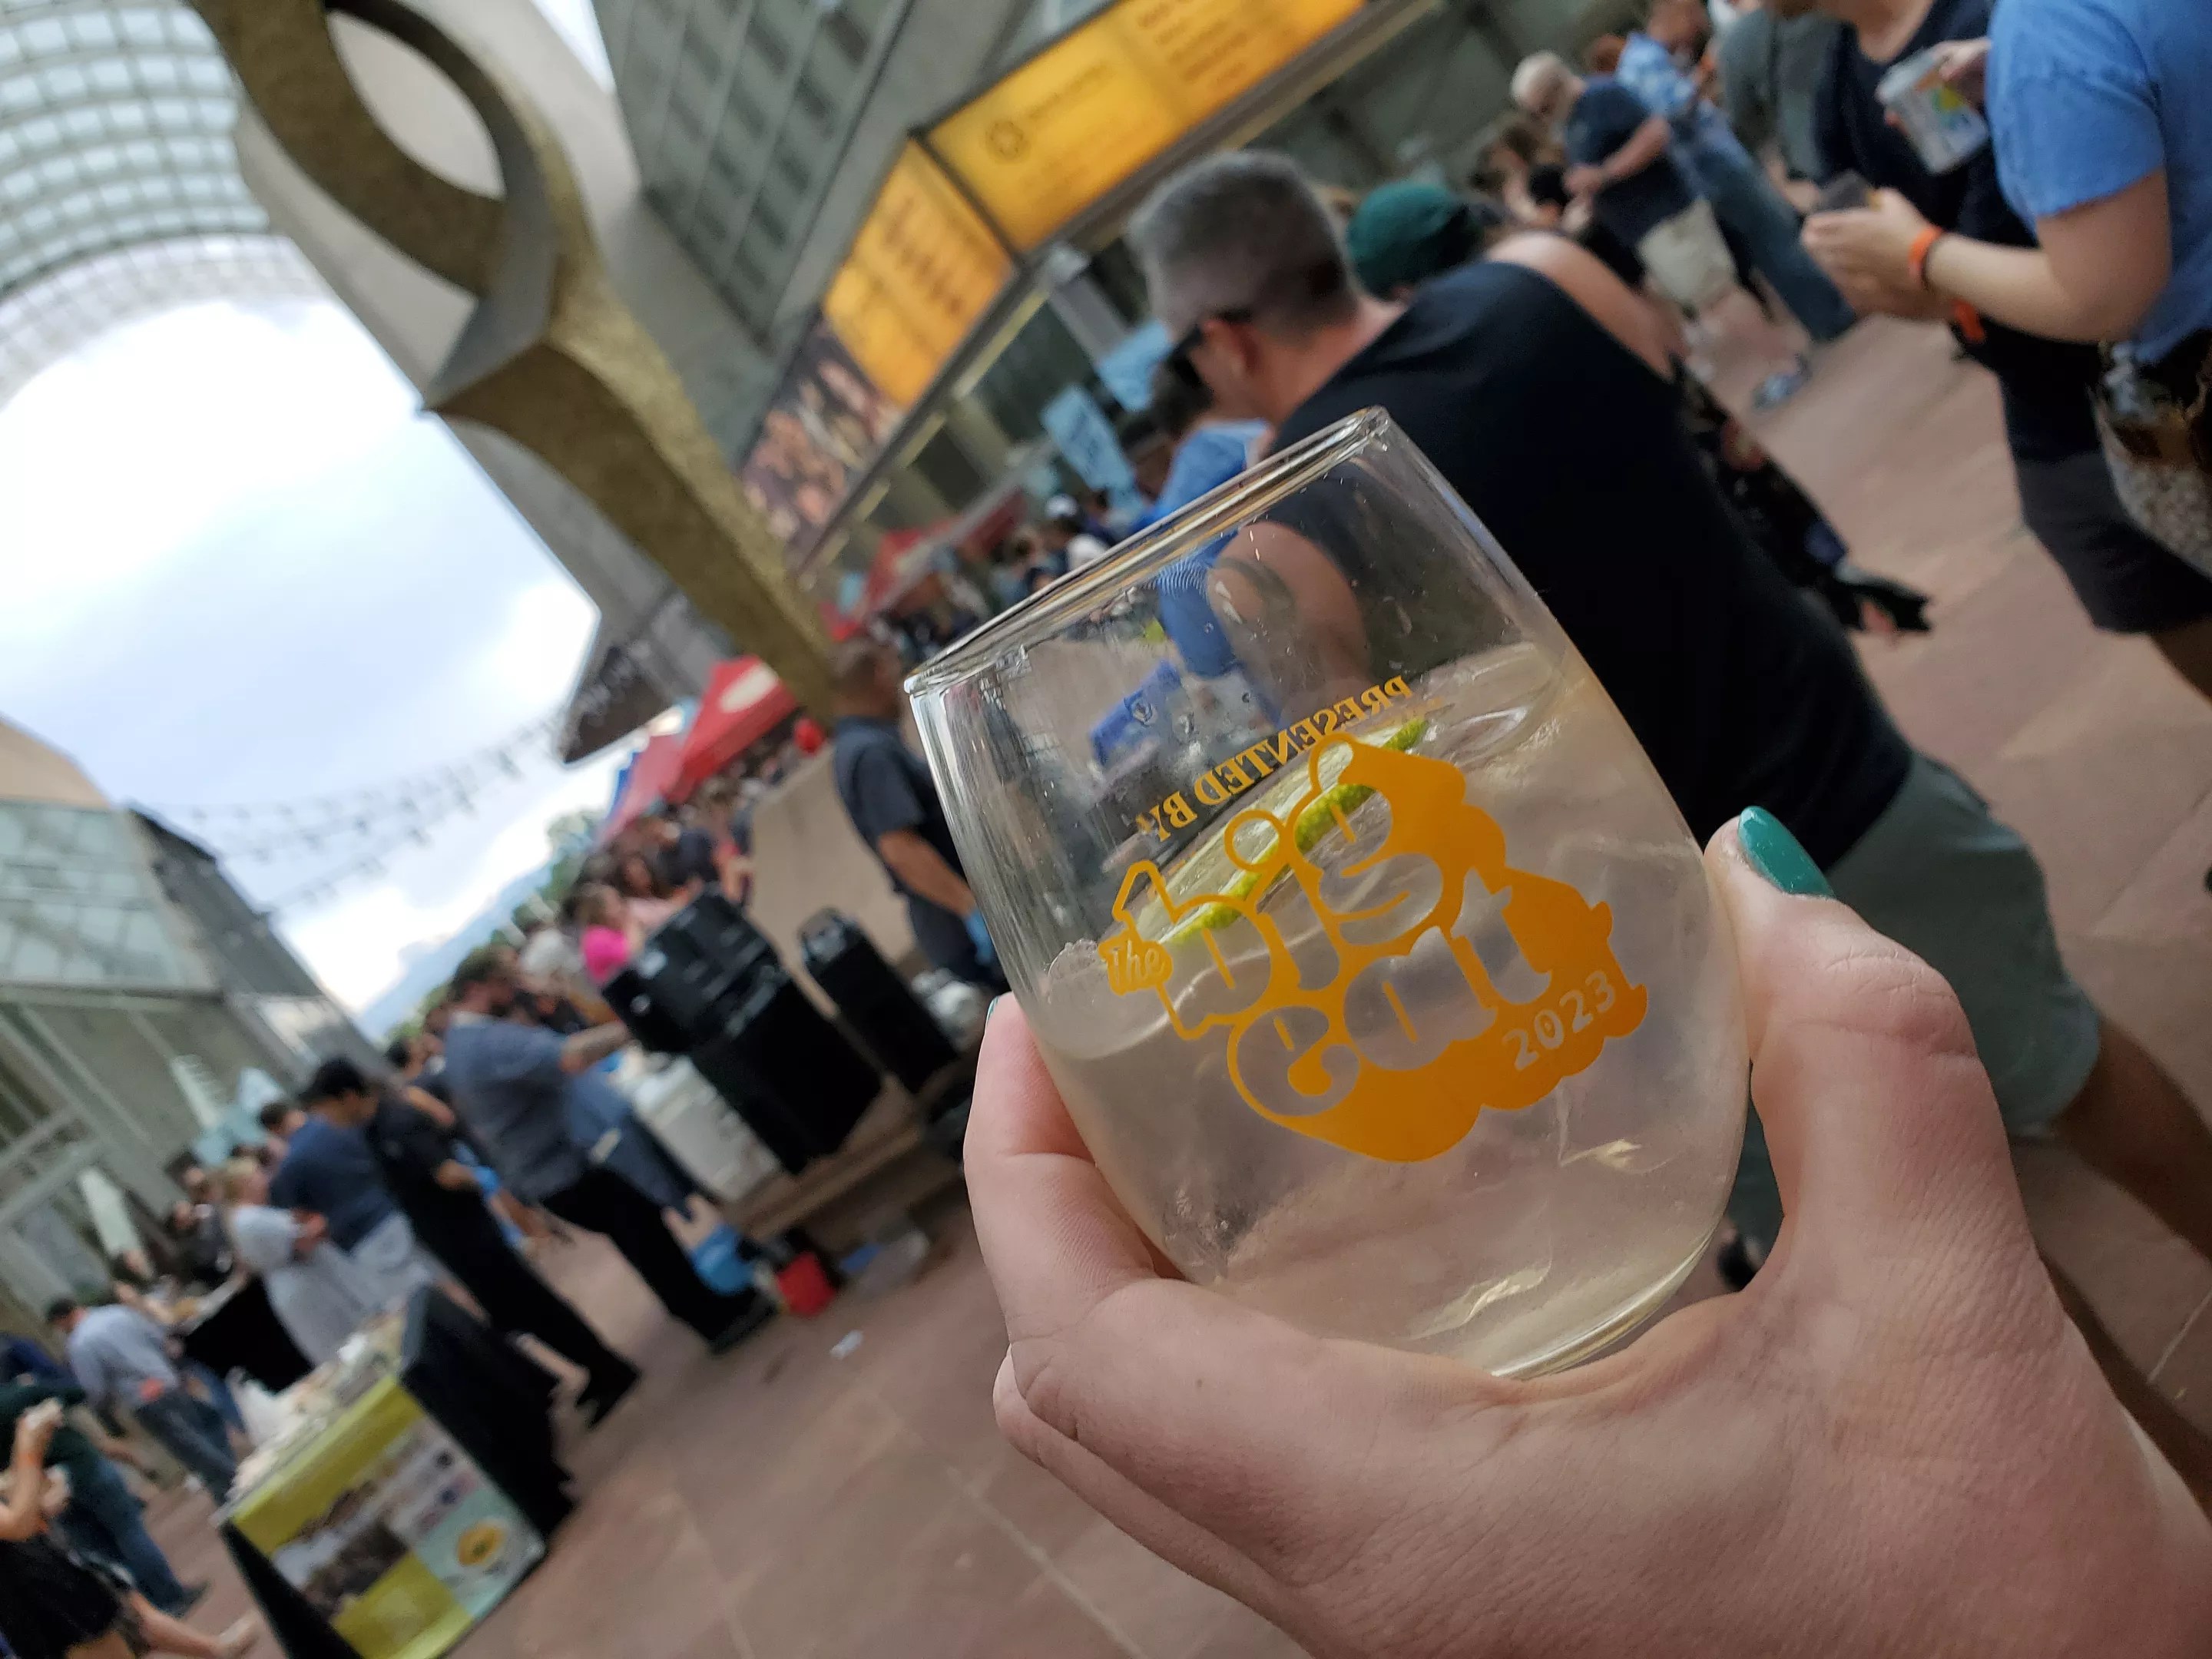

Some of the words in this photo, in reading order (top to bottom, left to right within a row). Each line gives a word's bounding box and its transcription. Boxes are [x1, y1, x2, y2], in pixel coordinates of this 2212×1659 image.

[1119, 737, 1445, 1035] big
[1237, 865, 1552, 1117] eat
[1502, 970, 1615, 1071] 2023
